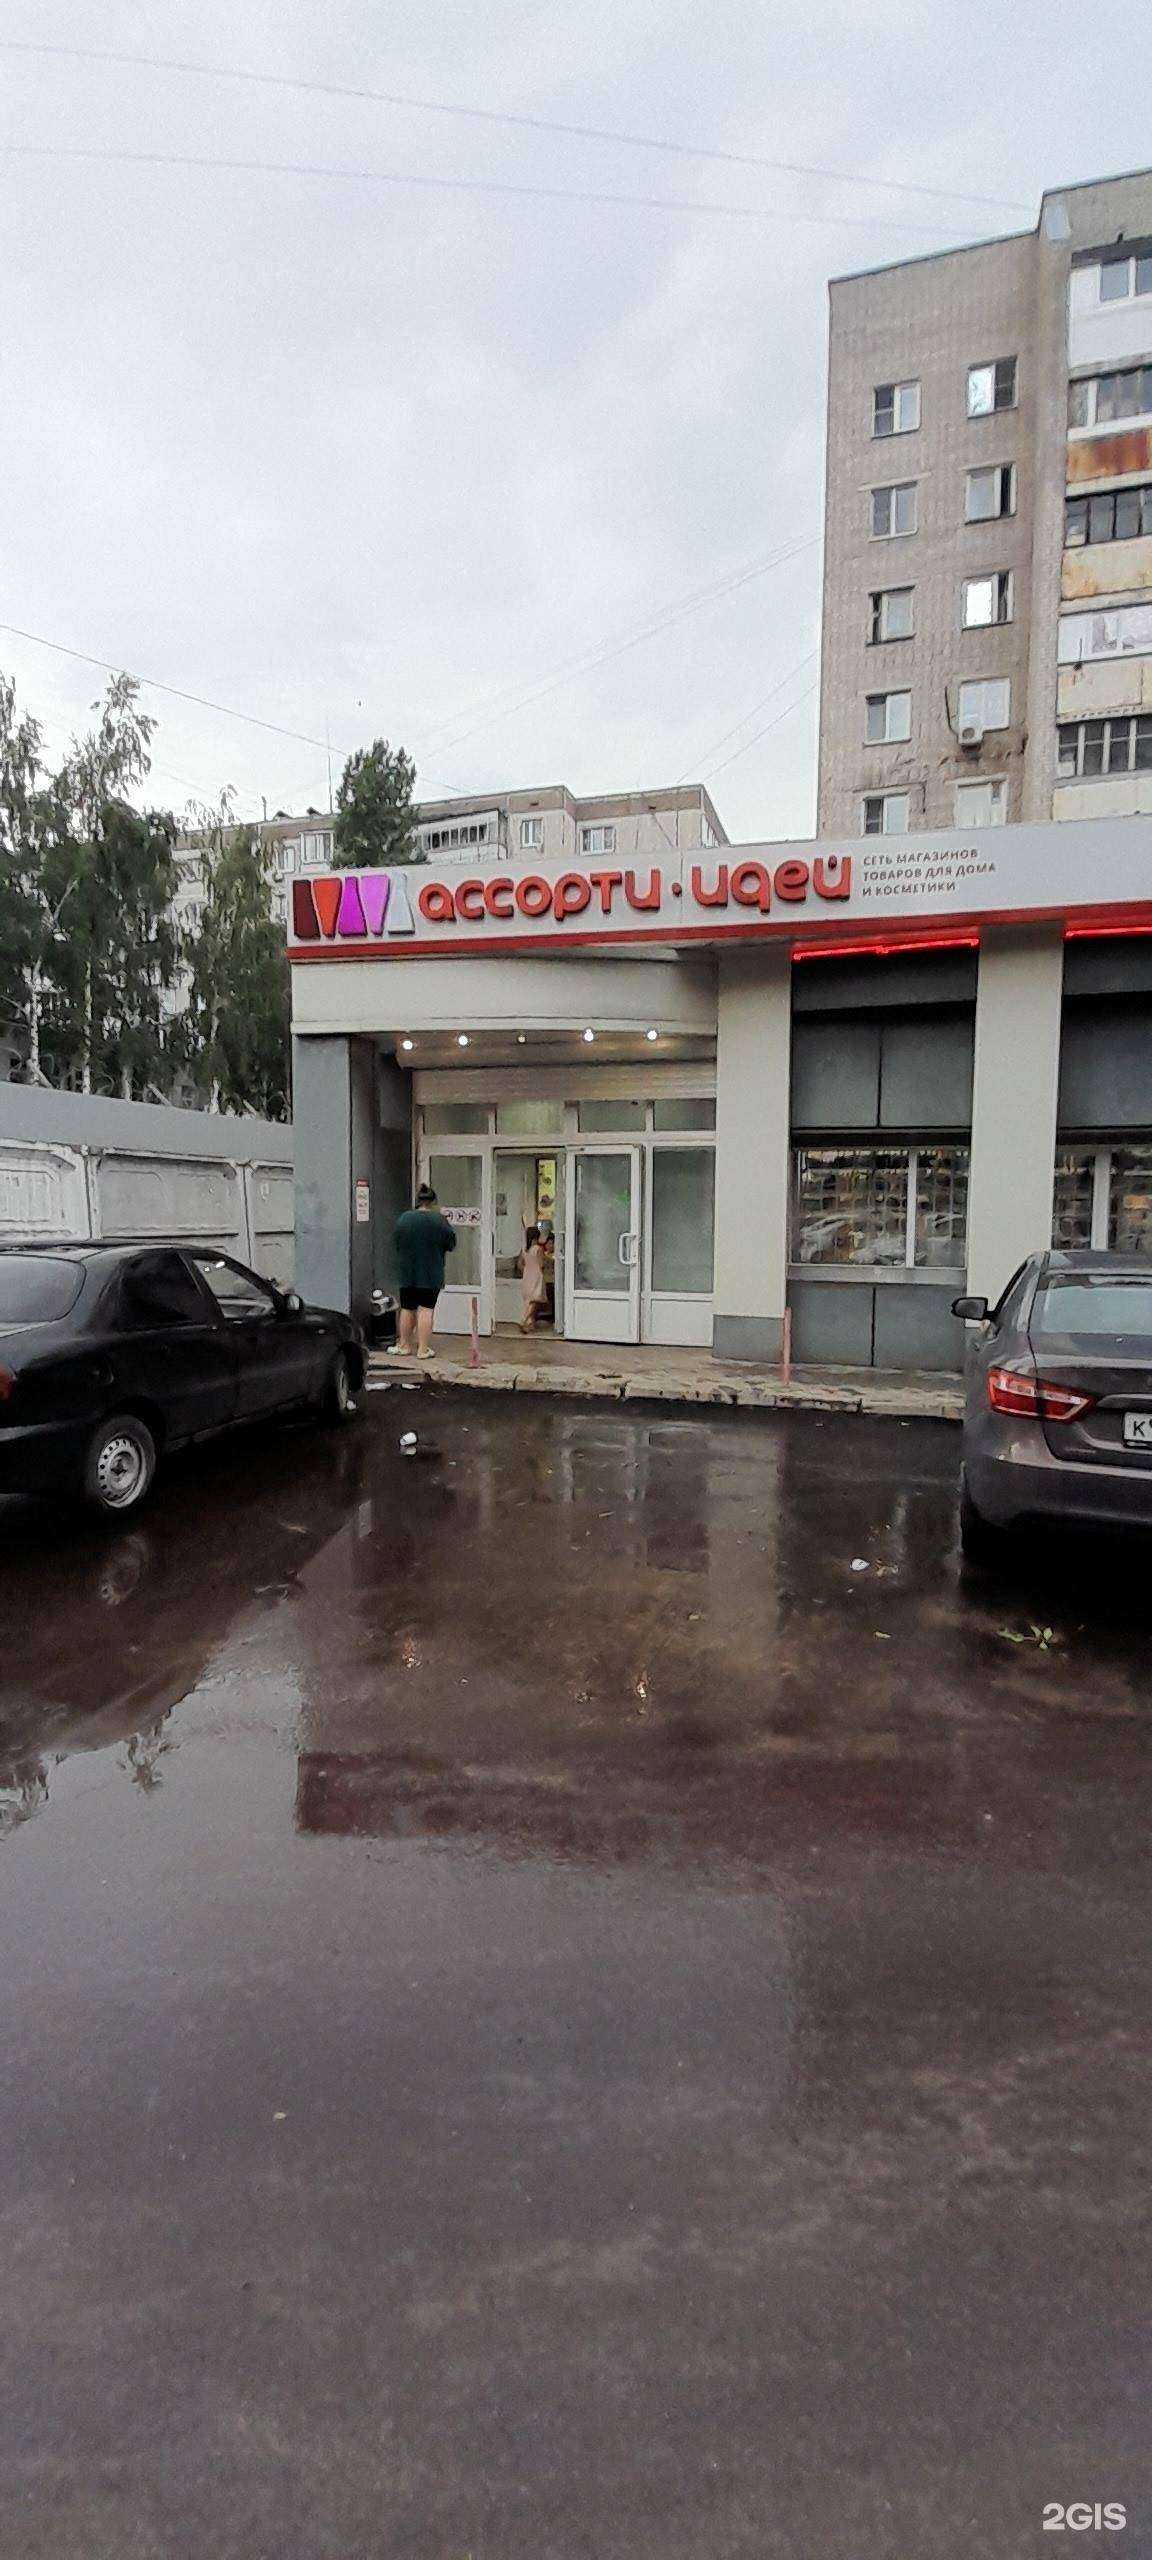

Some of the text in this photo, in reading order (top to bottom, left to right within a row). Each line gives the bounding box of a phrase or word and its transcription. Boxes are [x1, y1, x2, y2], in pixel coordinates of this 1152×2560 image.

[863, 848, 979, 866] СЕТЬ МАГАЗИНОВ
[863, 862, 996, 882] ТОВАРОВ ДЛЯ ДОМА
[418, 854, 852, 922] ассорти идей
[862, 881, 956, 897] И КОСМЕТИКИ
